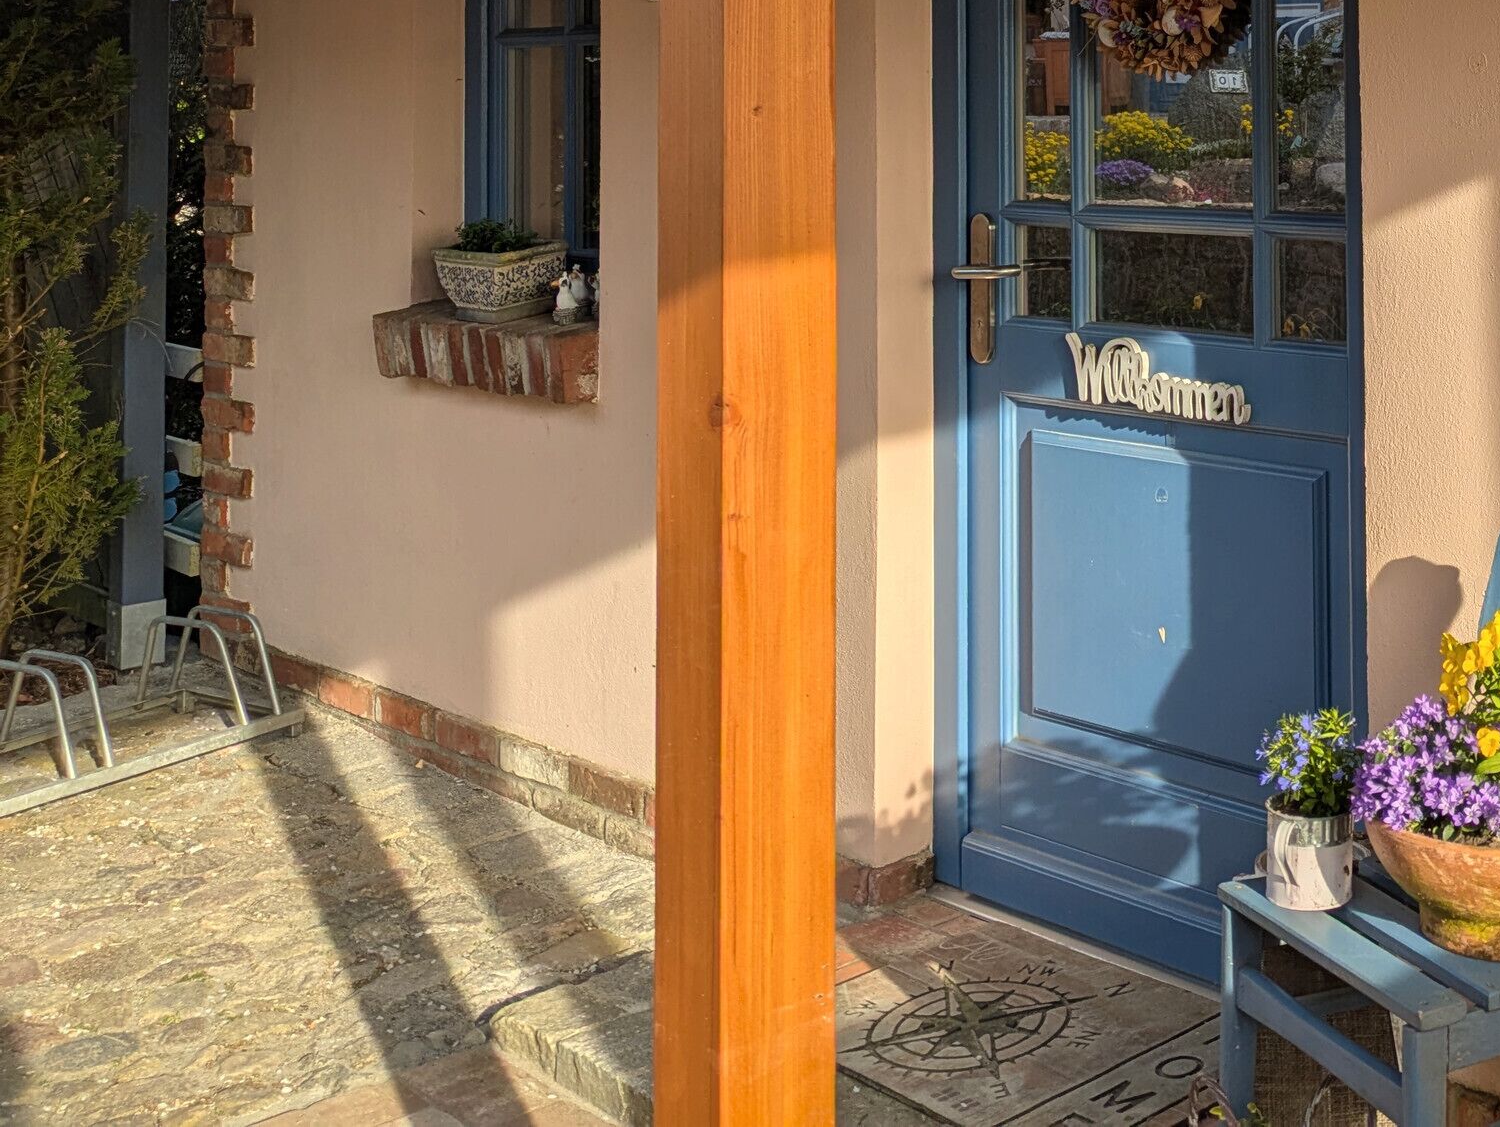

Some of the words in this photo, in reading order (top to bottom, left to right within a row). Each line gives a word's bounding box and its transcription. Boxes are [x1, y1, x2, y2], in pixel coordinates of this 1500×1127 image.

[1103, 981, 1136, 998] N
[1067, 1029, 1102, 1050] NE
[990, 1081, 1012, 1100] E
